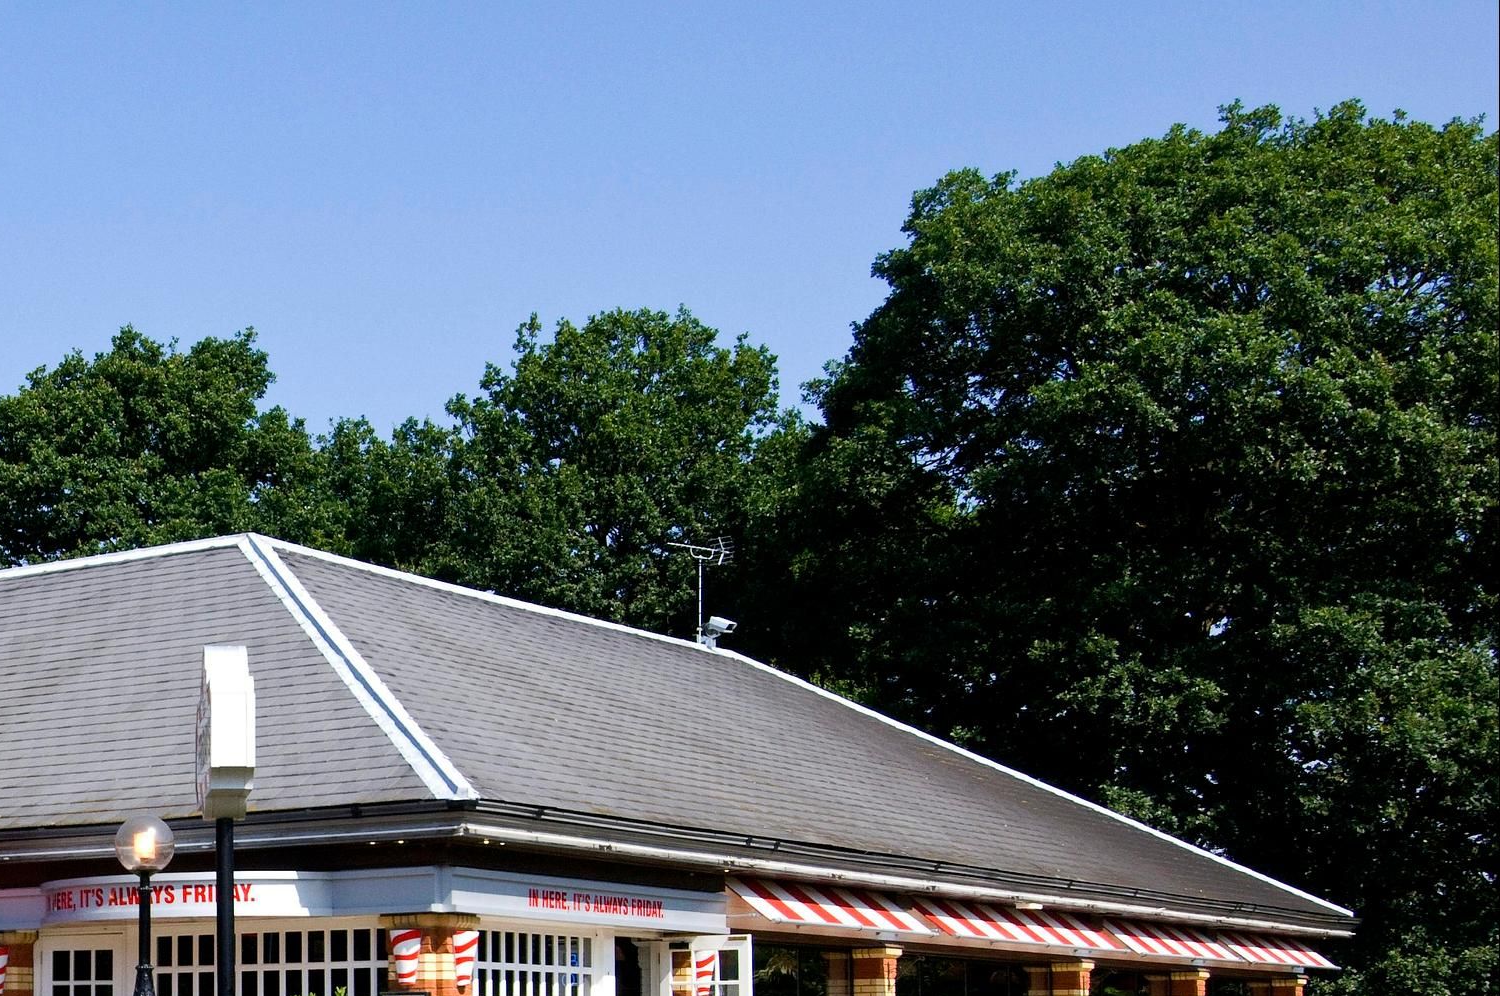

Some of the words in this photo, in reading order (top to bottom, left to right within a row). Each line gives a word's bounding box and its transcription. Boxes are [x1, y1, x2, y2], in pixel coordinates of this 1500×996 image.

[80, 887, 104, 908] IT'S
[108, 885, 175, 906] ALWYS
[182, 883, 255, 903] FRIAY.
[528, 888, 539, 908] IN
[542, 890, 570, 912] HERE,
[573, 893, 591, 912] IT'S
[593, 895, 629, 916] ALWAYS
[631, 898, 664, 918] FRIDAY.
